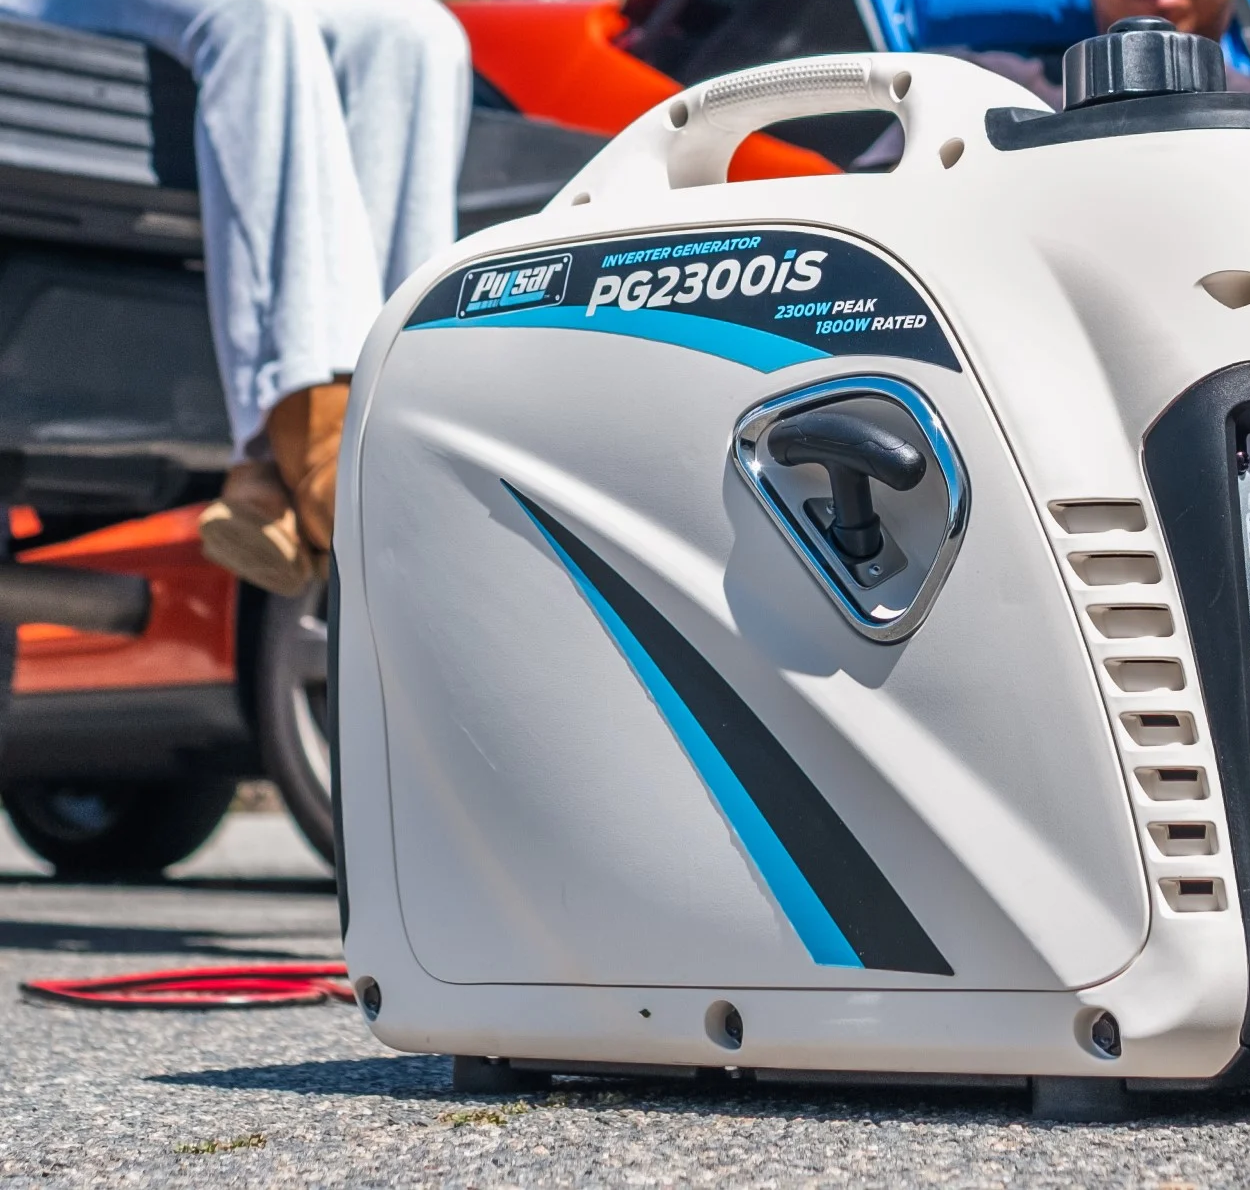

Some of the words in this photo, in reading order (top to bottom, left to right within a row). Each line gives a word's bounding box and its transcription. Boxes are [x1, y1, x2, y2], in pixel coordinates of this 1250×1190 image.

[601, 246, 672, 269] INVERTER
[672, 236, 762, 259] GENERATOR
[585, 249, 829, 318] PG2300iS
[774, 301, 832, 320] 2300W
[831, 298, 878, 315] PEAK
[815, 317, 872, 335] 1800W
[871, 314, 927, 331] RATED
